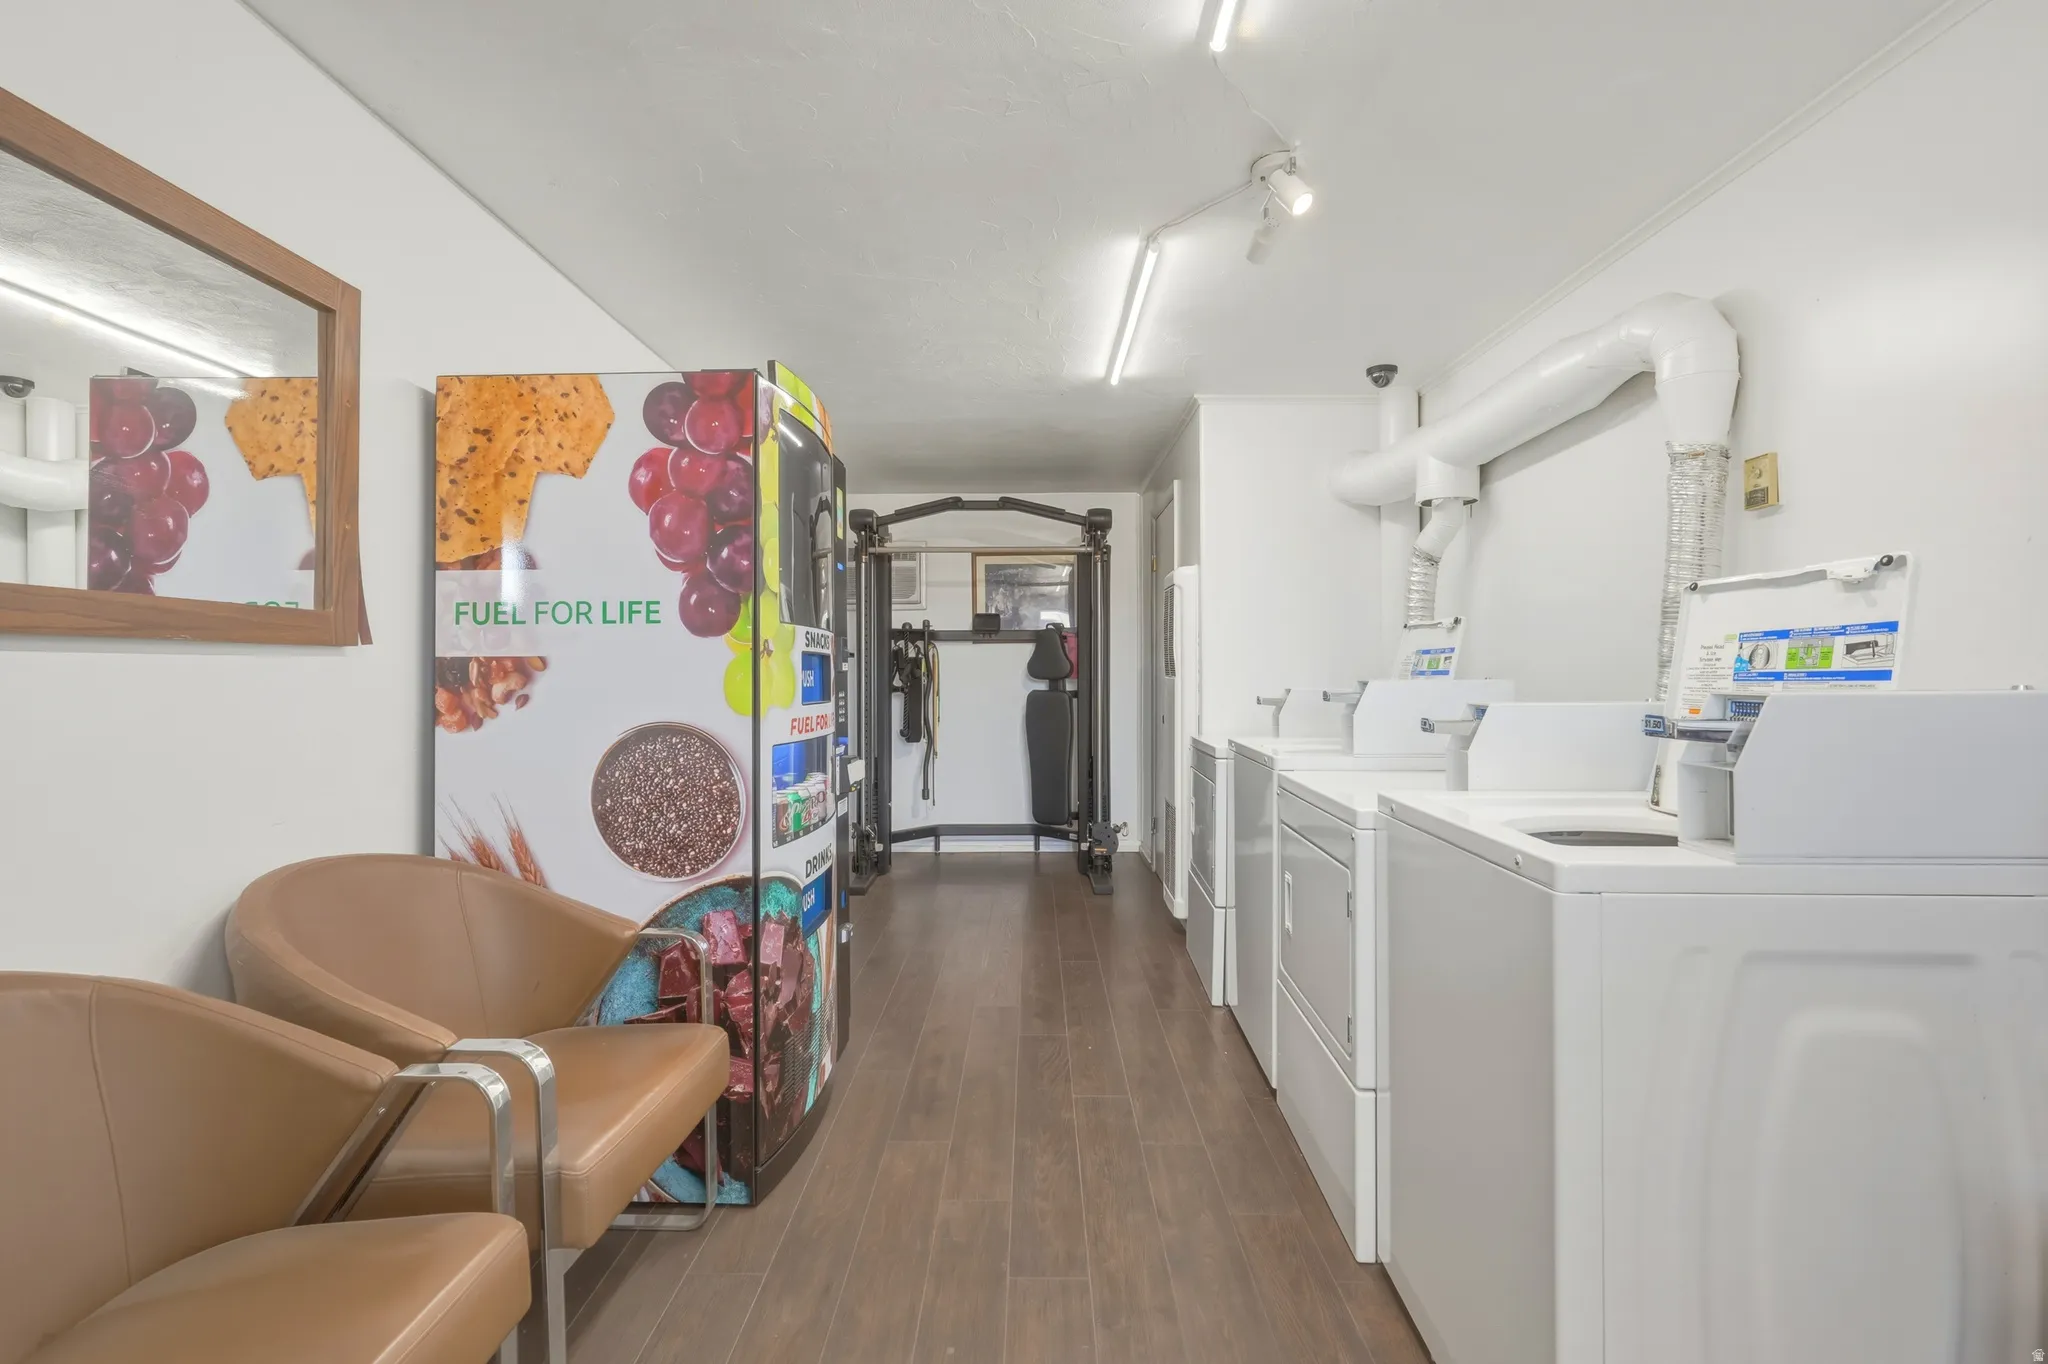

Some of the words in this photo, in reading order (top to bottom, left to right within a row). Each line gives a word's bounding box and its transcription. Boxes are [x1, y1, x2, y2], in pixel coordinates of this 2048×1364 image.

[454, 601, 527, 626] FUEL
[534, 600, 594, 625] FOR
[601, 600, 662, 625] LIFE
[804, 630, 830, 650] SNACKS
[790, 715, 815, 736] FUEL
[815, 713, 828, 731] FOR
[805, 843, 833, 880] DRINKS
[802, 887, 815, 912] USH
